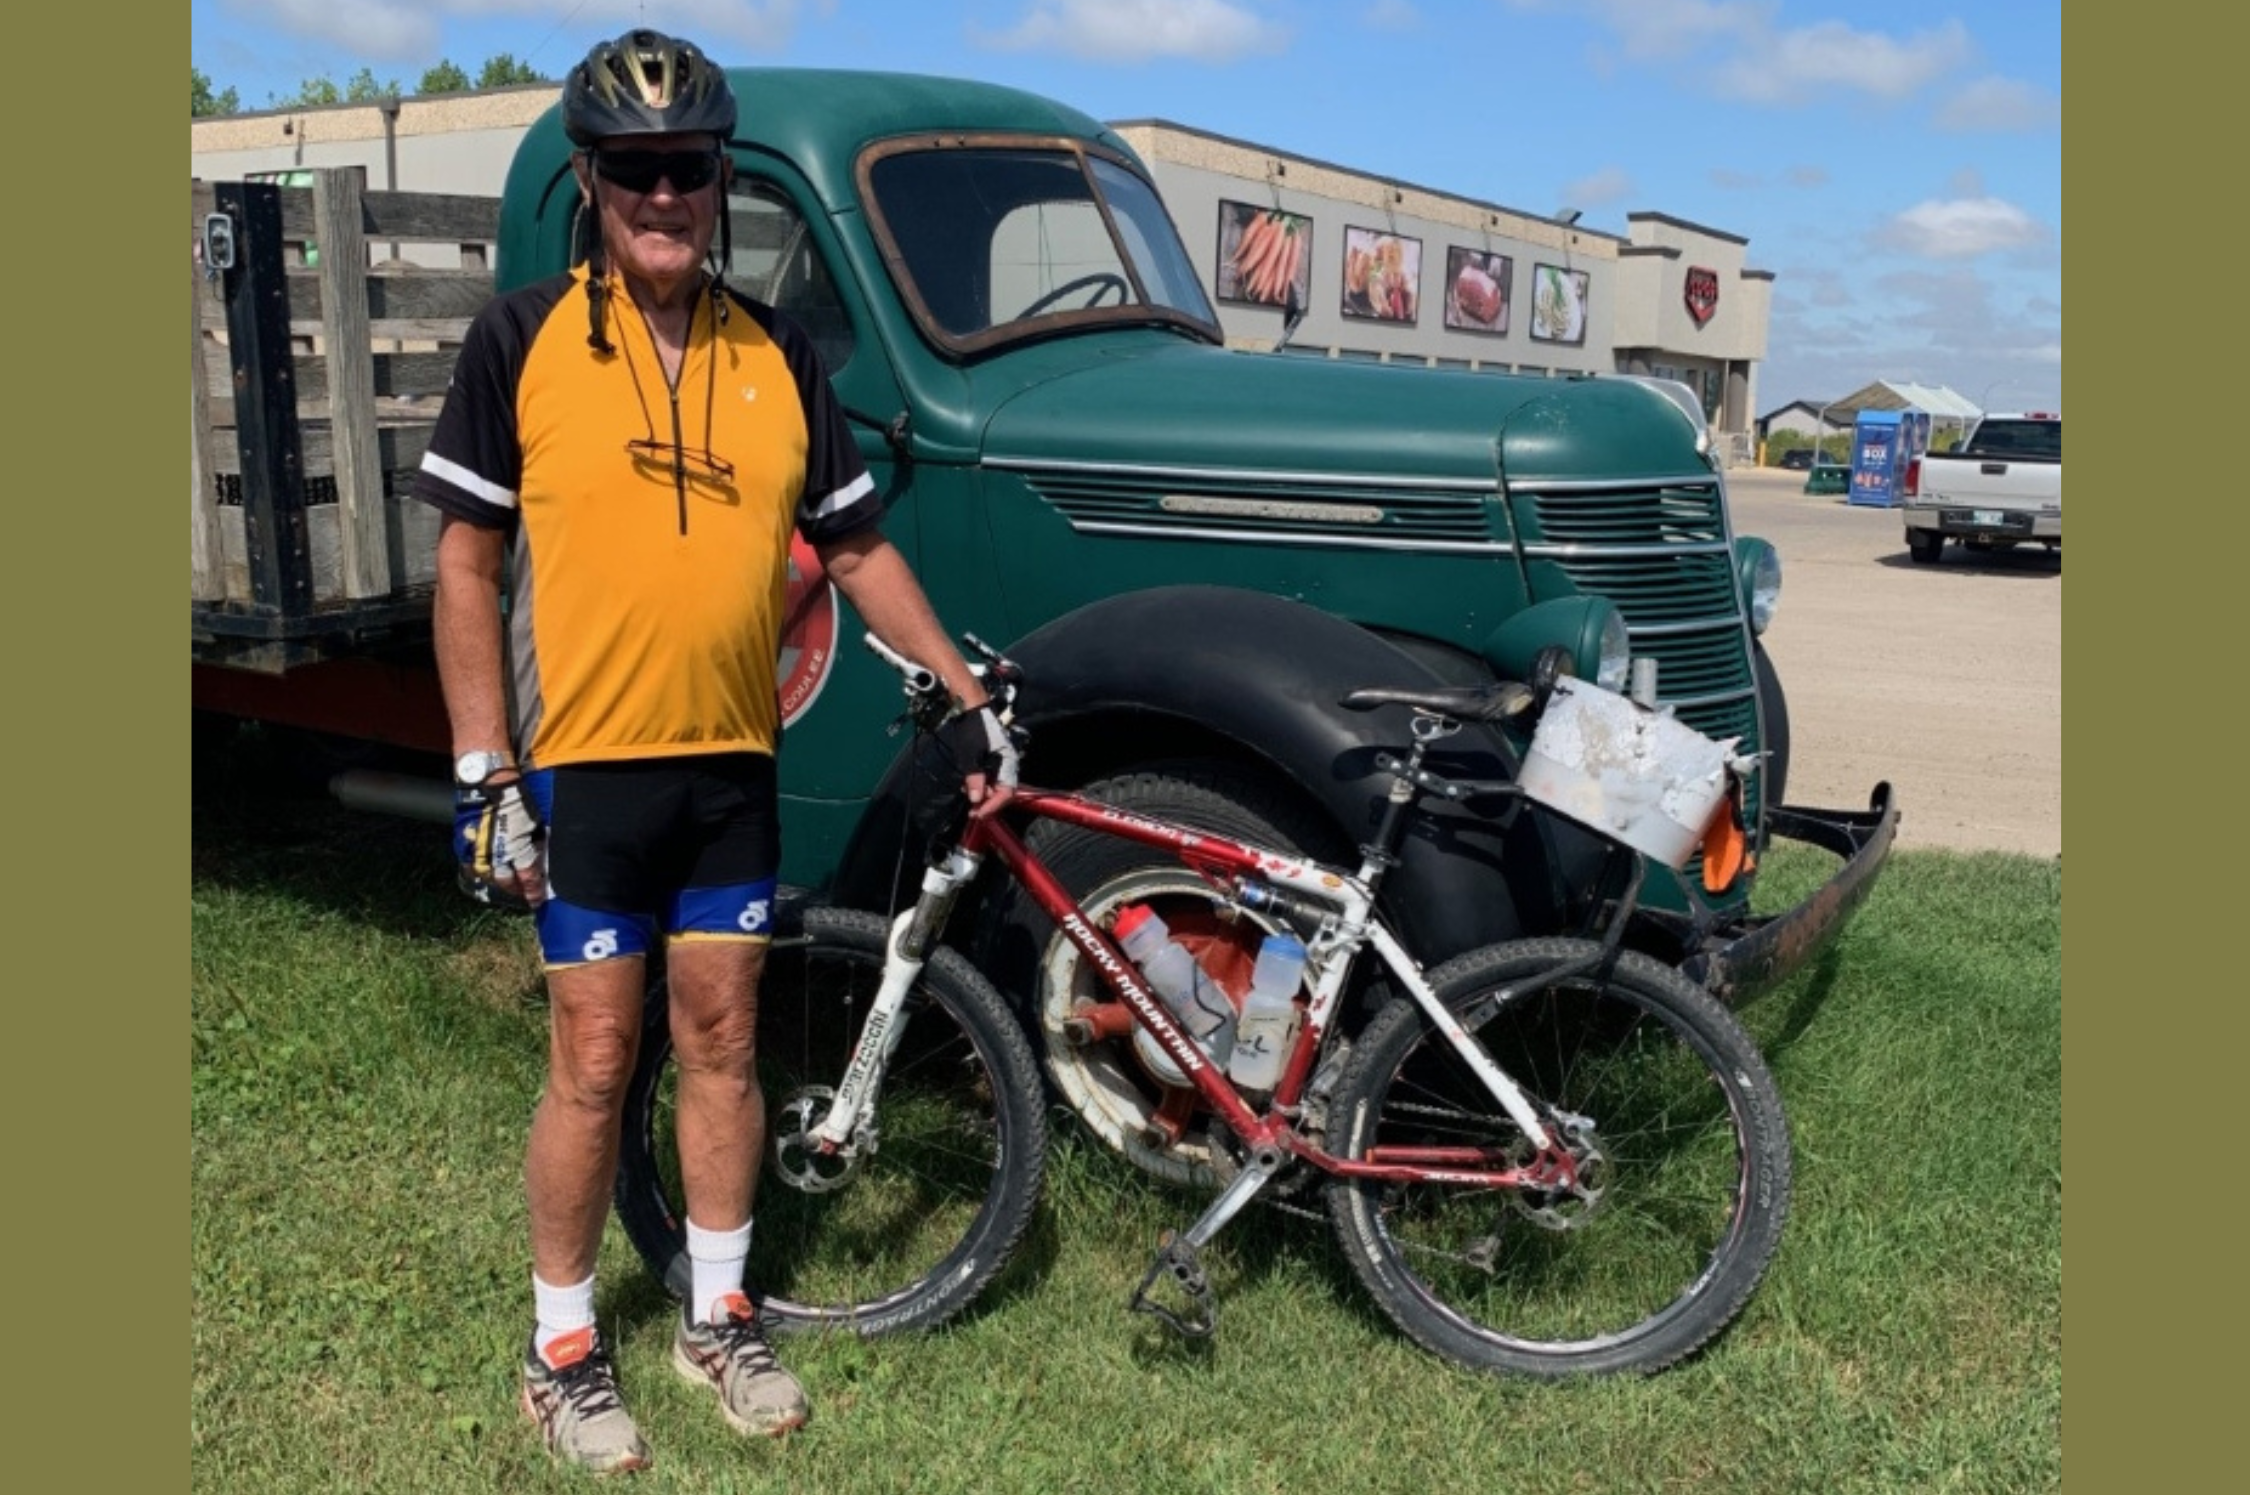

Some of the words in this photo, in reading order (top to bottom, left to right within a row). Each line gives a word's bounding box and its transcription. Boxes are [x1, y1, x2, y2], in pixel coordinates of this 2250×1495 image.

[1862, 448, 1887, 459] BOX
[1063, 912, 1123, 974] ROCKY
[1115, 974, 1205, 1071] MOUNTAIN
[1743, 1086, 1774, 1209] BONTRAGER
